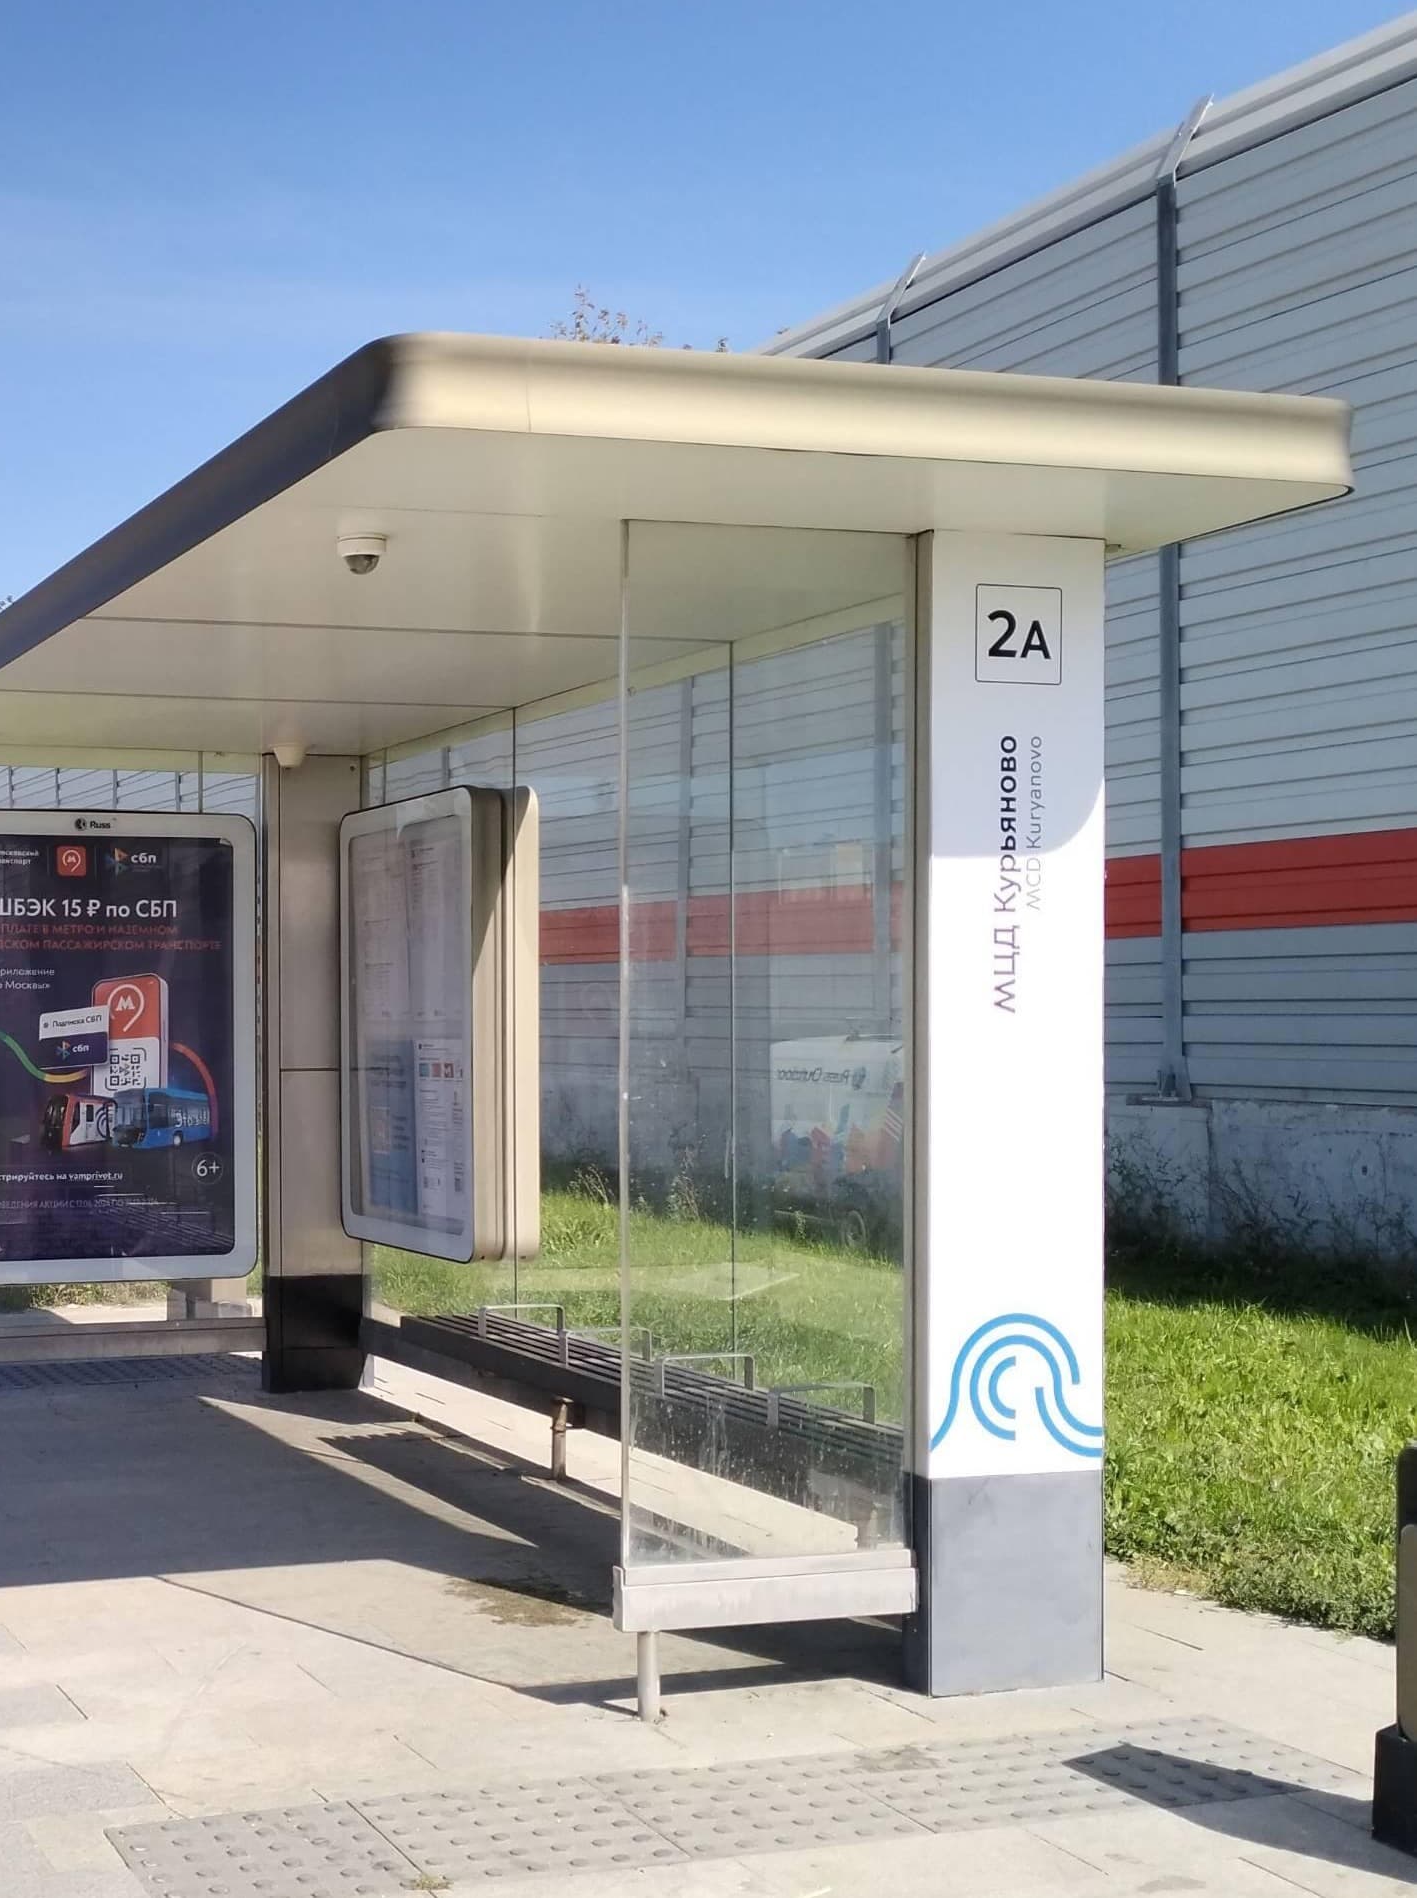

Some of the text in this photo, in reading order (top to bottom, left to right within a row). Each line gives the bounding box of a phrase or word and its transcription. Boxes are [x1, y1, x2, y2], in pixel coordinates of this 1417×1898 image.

[90, 820, 111, 829] Russ
[1026, 735, 1047, 910] MCD Kuryanovo
[131, 852, 157, 864] сбп
[993, 735, 1021, 1014] МЦД Курьяново
[61, 899, 82, 917] 15
[106, 904, 130, 918] по
[135, 900, 177, 918] СБП
[52, 924, 94, 935] МЕТРО
[108, 924, 180, 936] НАЗЕМНОМ
[43, 939, 145, 950] ПАССАЖИРСКОМ
[72, 1043, 90, 1053] сбп
[196, 1160, 220, 1177] 6+
[56, 1173, 67, 1181] на
